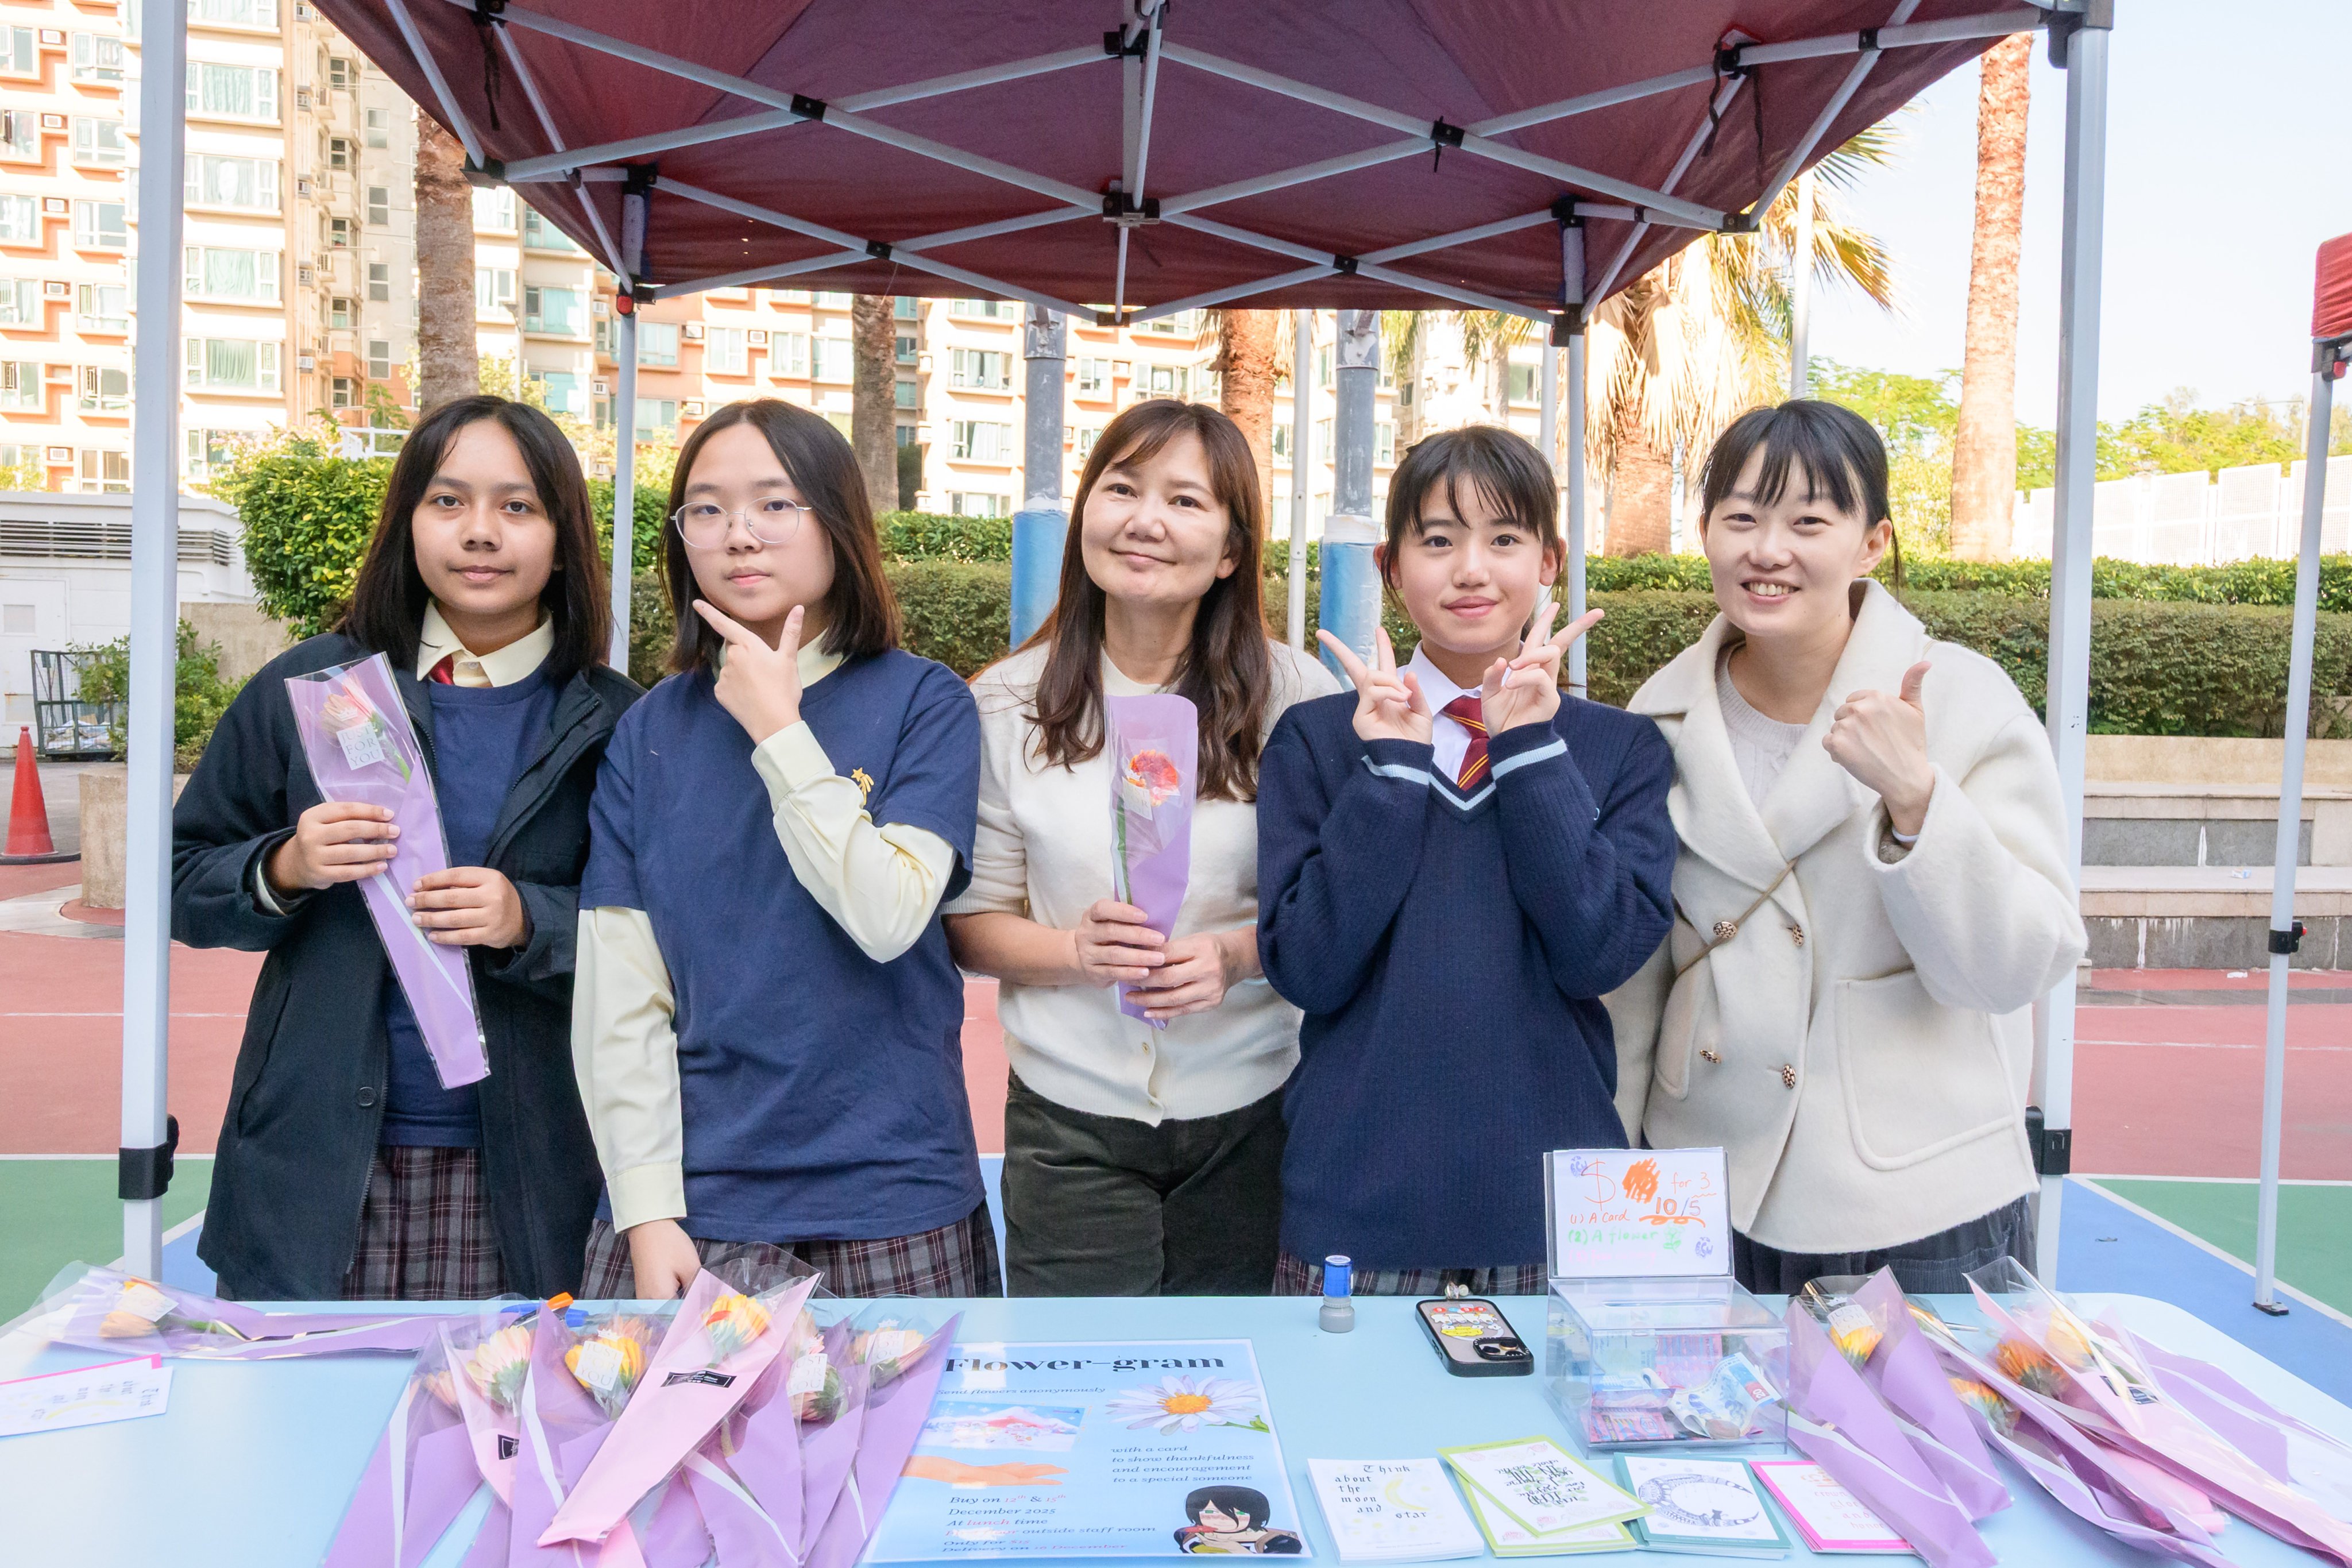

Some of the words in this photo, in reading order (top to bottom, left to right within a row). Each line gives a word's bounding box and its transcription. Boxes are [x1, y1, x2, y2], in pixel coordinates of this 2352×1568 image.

[346, 738, 377, 754] FOR
[350, 749, 380, 766] YOU
[1671, 1172, 1691, 1194] for
[1700, 1172, 1710, 1189] 3
[1589, 1212, 1597, 1224] A
[1568, 1230, 1588, 1245] (2)
[1592, 1230, 1602, 1243] A
[1609, 1227, 1660, 1245] flower
[945, 1357, 1226, 1373] Flower-gram
[1144, 1465, 1251, 1473] encouragement
[1364, 1465, 1411, 1475] Think
[1141, 1476, 1189, 1484] special
[1335, 1475, 1372, 1483] about
[1338, 1485, 1360, 1494] the
[1357, 1504, 1382, 1513] and
[1843, 1511, 1871, 1519] and
